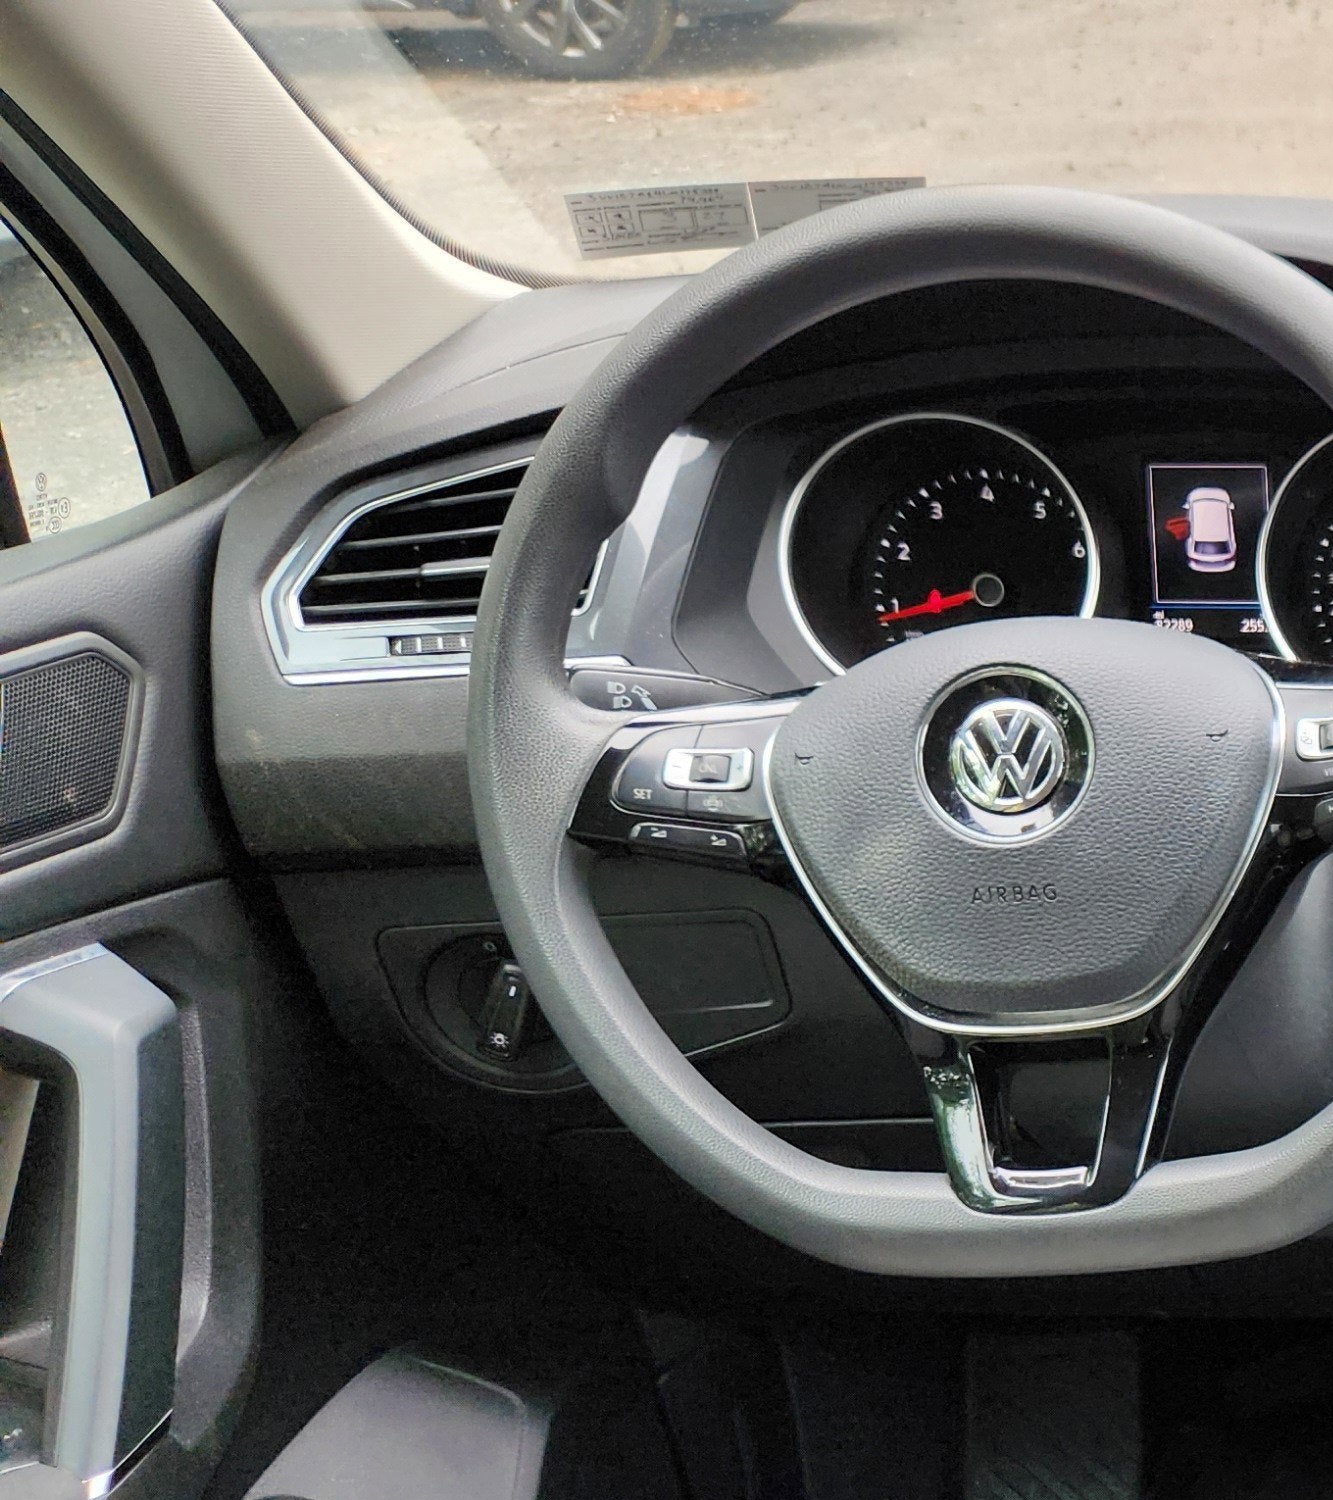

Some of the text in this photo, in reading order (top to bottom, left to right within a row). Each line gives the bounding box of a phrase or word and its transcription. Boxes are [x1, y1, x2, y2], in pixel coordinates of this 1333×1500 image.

[980, 484, 995, 502] 4
[929, 501, 943, 520] 3
[1033, 501, 1047, 519] 5
[897, 543, 911, 561] 2
[1072, 539, 1086, 558] 6
[633, 788, 653, 800] SET
[971, 883, 1058, 904] AIRBAG
